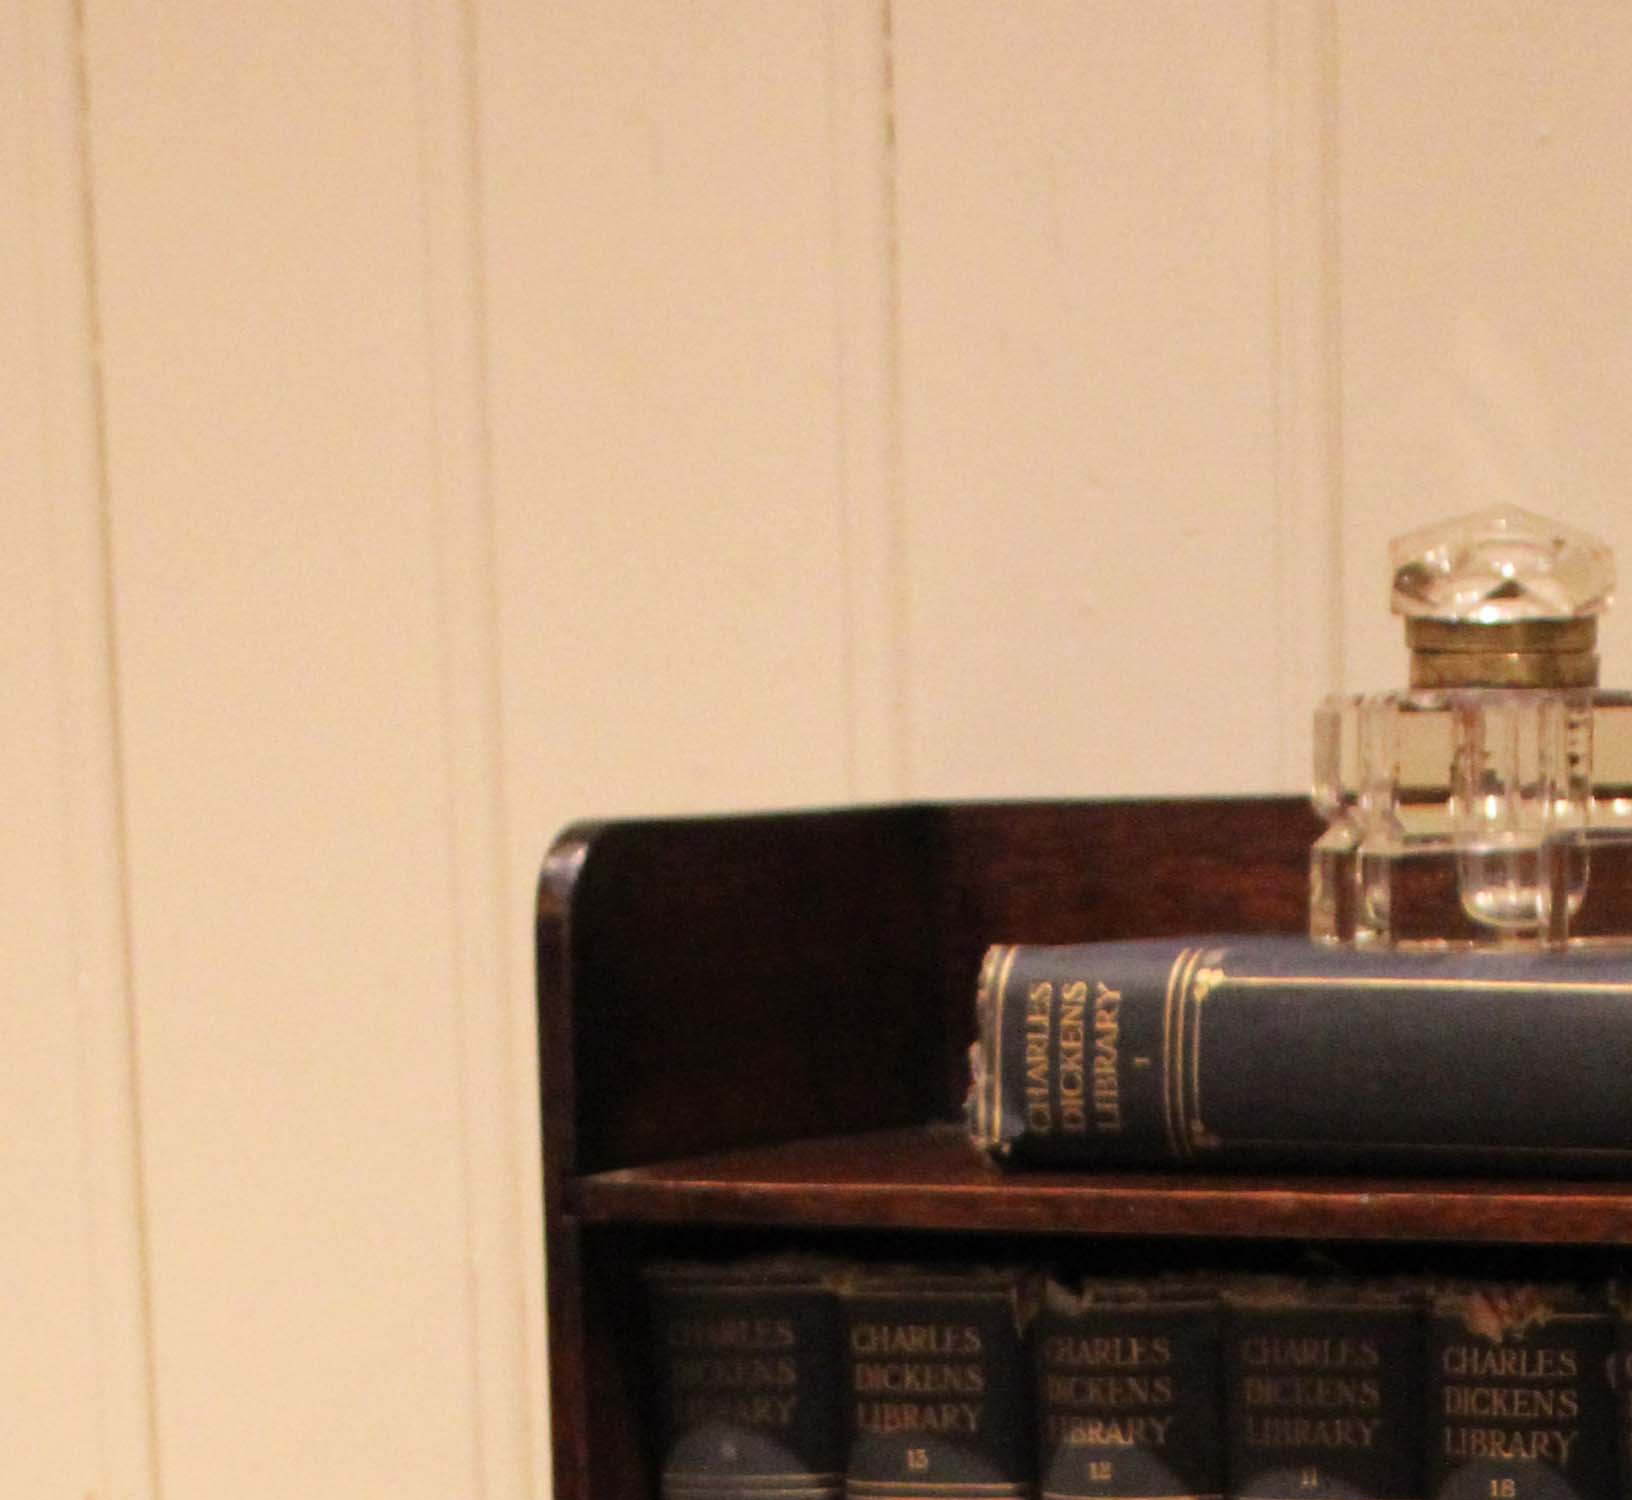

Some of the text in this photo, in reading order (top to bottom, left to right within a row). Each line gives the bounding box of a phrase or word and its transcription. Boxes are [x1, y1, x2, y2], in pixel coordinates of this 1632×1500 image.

[1025, 981, 1053, 1135] CHARLES
[1059, 980, 1088, 1133] DICKENS
[1093, 982, 1120, 1134] LIBRARY
[851, 1325, 982, 1354] CHARLES
[1442, 1345, 1577, 1376] CHARLES
[853, 1362, 985, 1392] DICKENS
[856, 1402, 980, 1432] LIBRARY
[1442, 1386, 1579, 1417] DICKENS
[1443, 1427, 1579, 1460] LIBRARY
